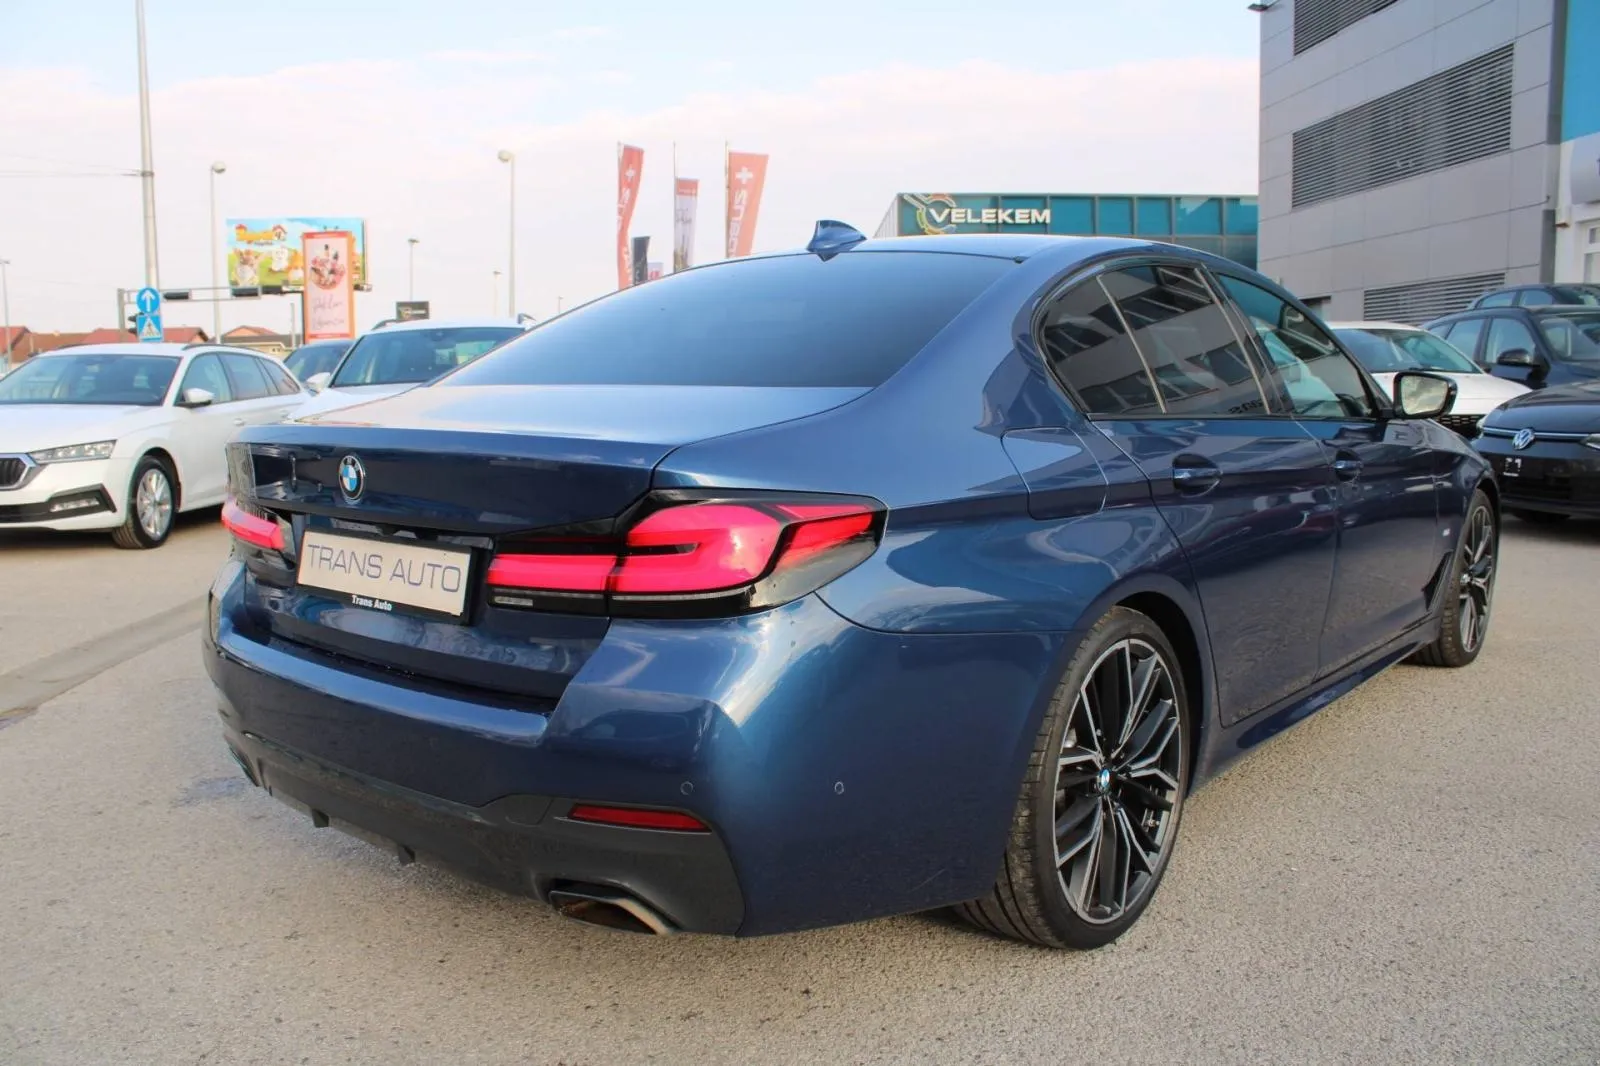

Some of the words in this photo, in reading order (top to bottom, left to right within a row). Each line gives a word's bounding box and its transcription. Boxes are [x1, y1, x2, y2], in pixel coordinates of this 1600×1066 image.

[928, 208, 1051, 224] VELEKEM
[307, 543, 384, 579] TRANS
[389, 558, 462, 593] AUTO
[351, 594, 373, 607] Trans
[373, 599, 392, 611] Auto
